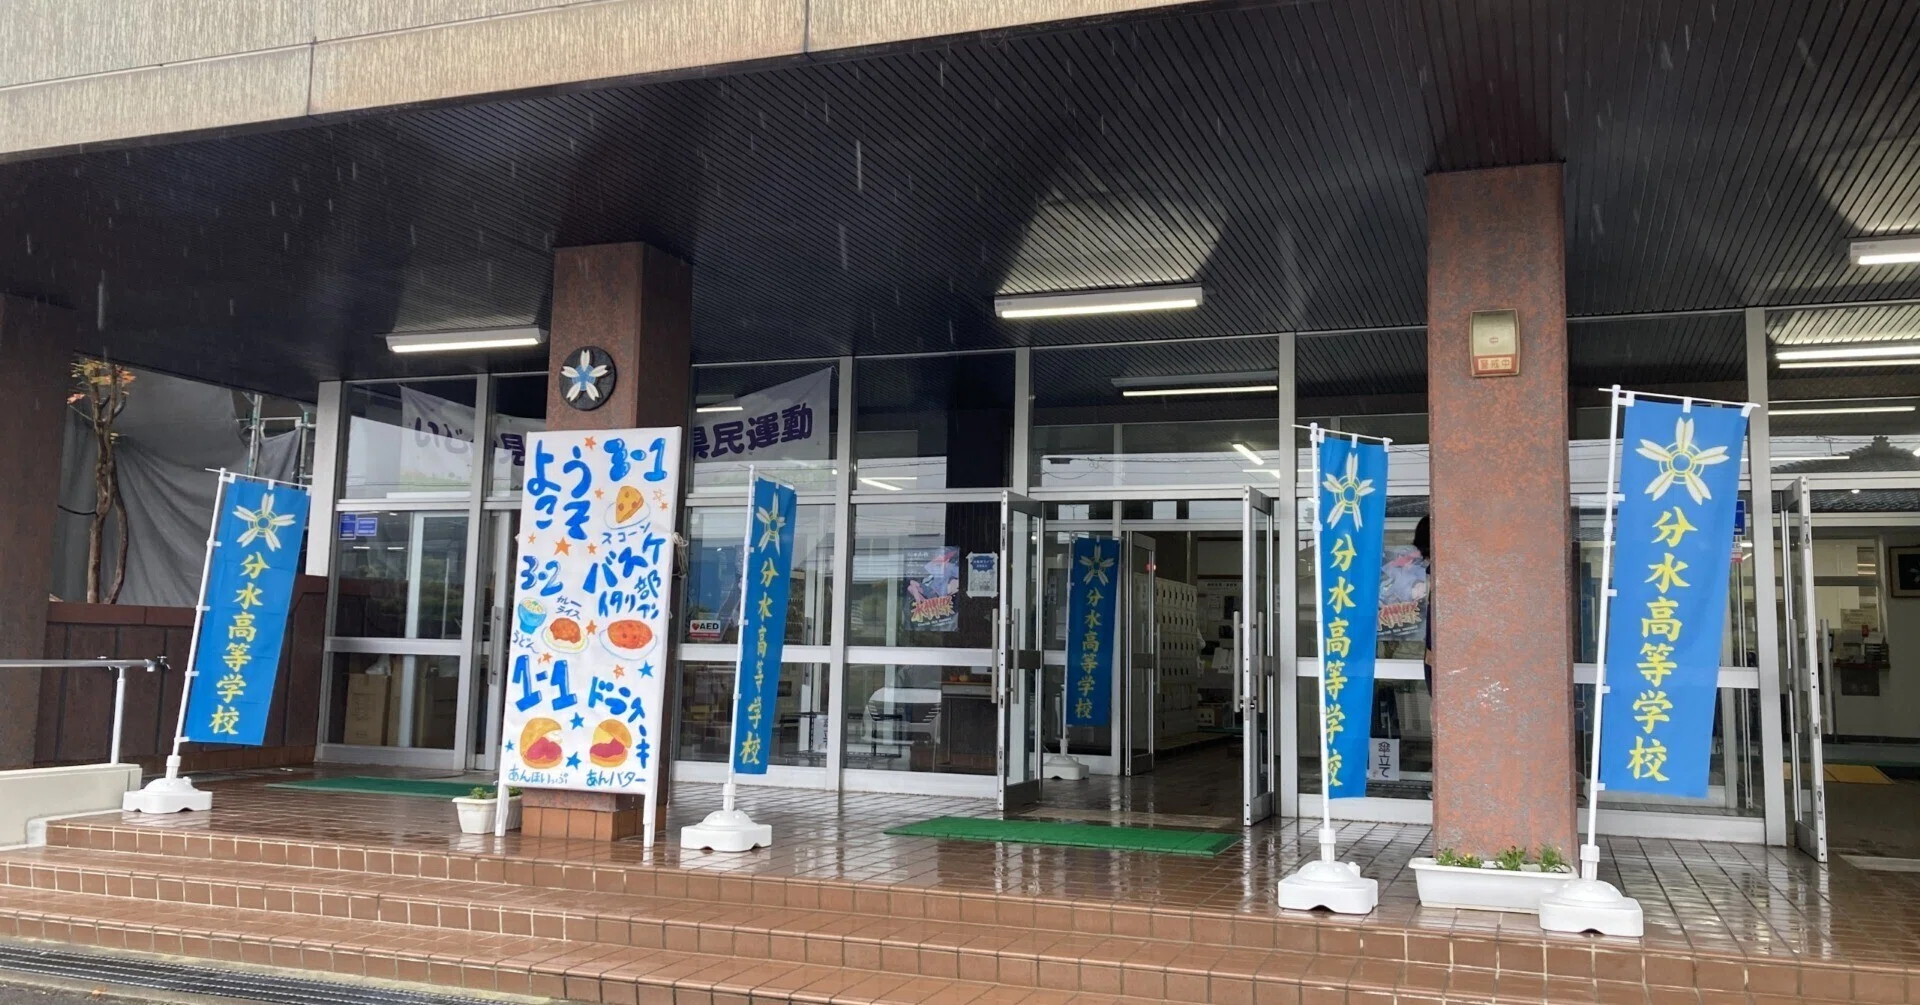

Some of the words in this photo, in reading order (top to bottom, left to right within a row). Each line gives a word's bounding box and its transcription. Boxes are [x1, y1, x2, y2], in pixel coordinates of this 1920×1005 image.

[602, 523, 651, 544] スコーン
[512, 629, 539, 654] うどん
[700, 622, 719, 630] AED
[209, 551, 271, 735] 分水高等学校
[1075, 587, 1104, 719] 分水高等学校
[1626, 506, 1699, 782] 分水高等学校
[1378, 741, 1391, 778] 傘立て
[586, 769, 647, 788] あんバター
